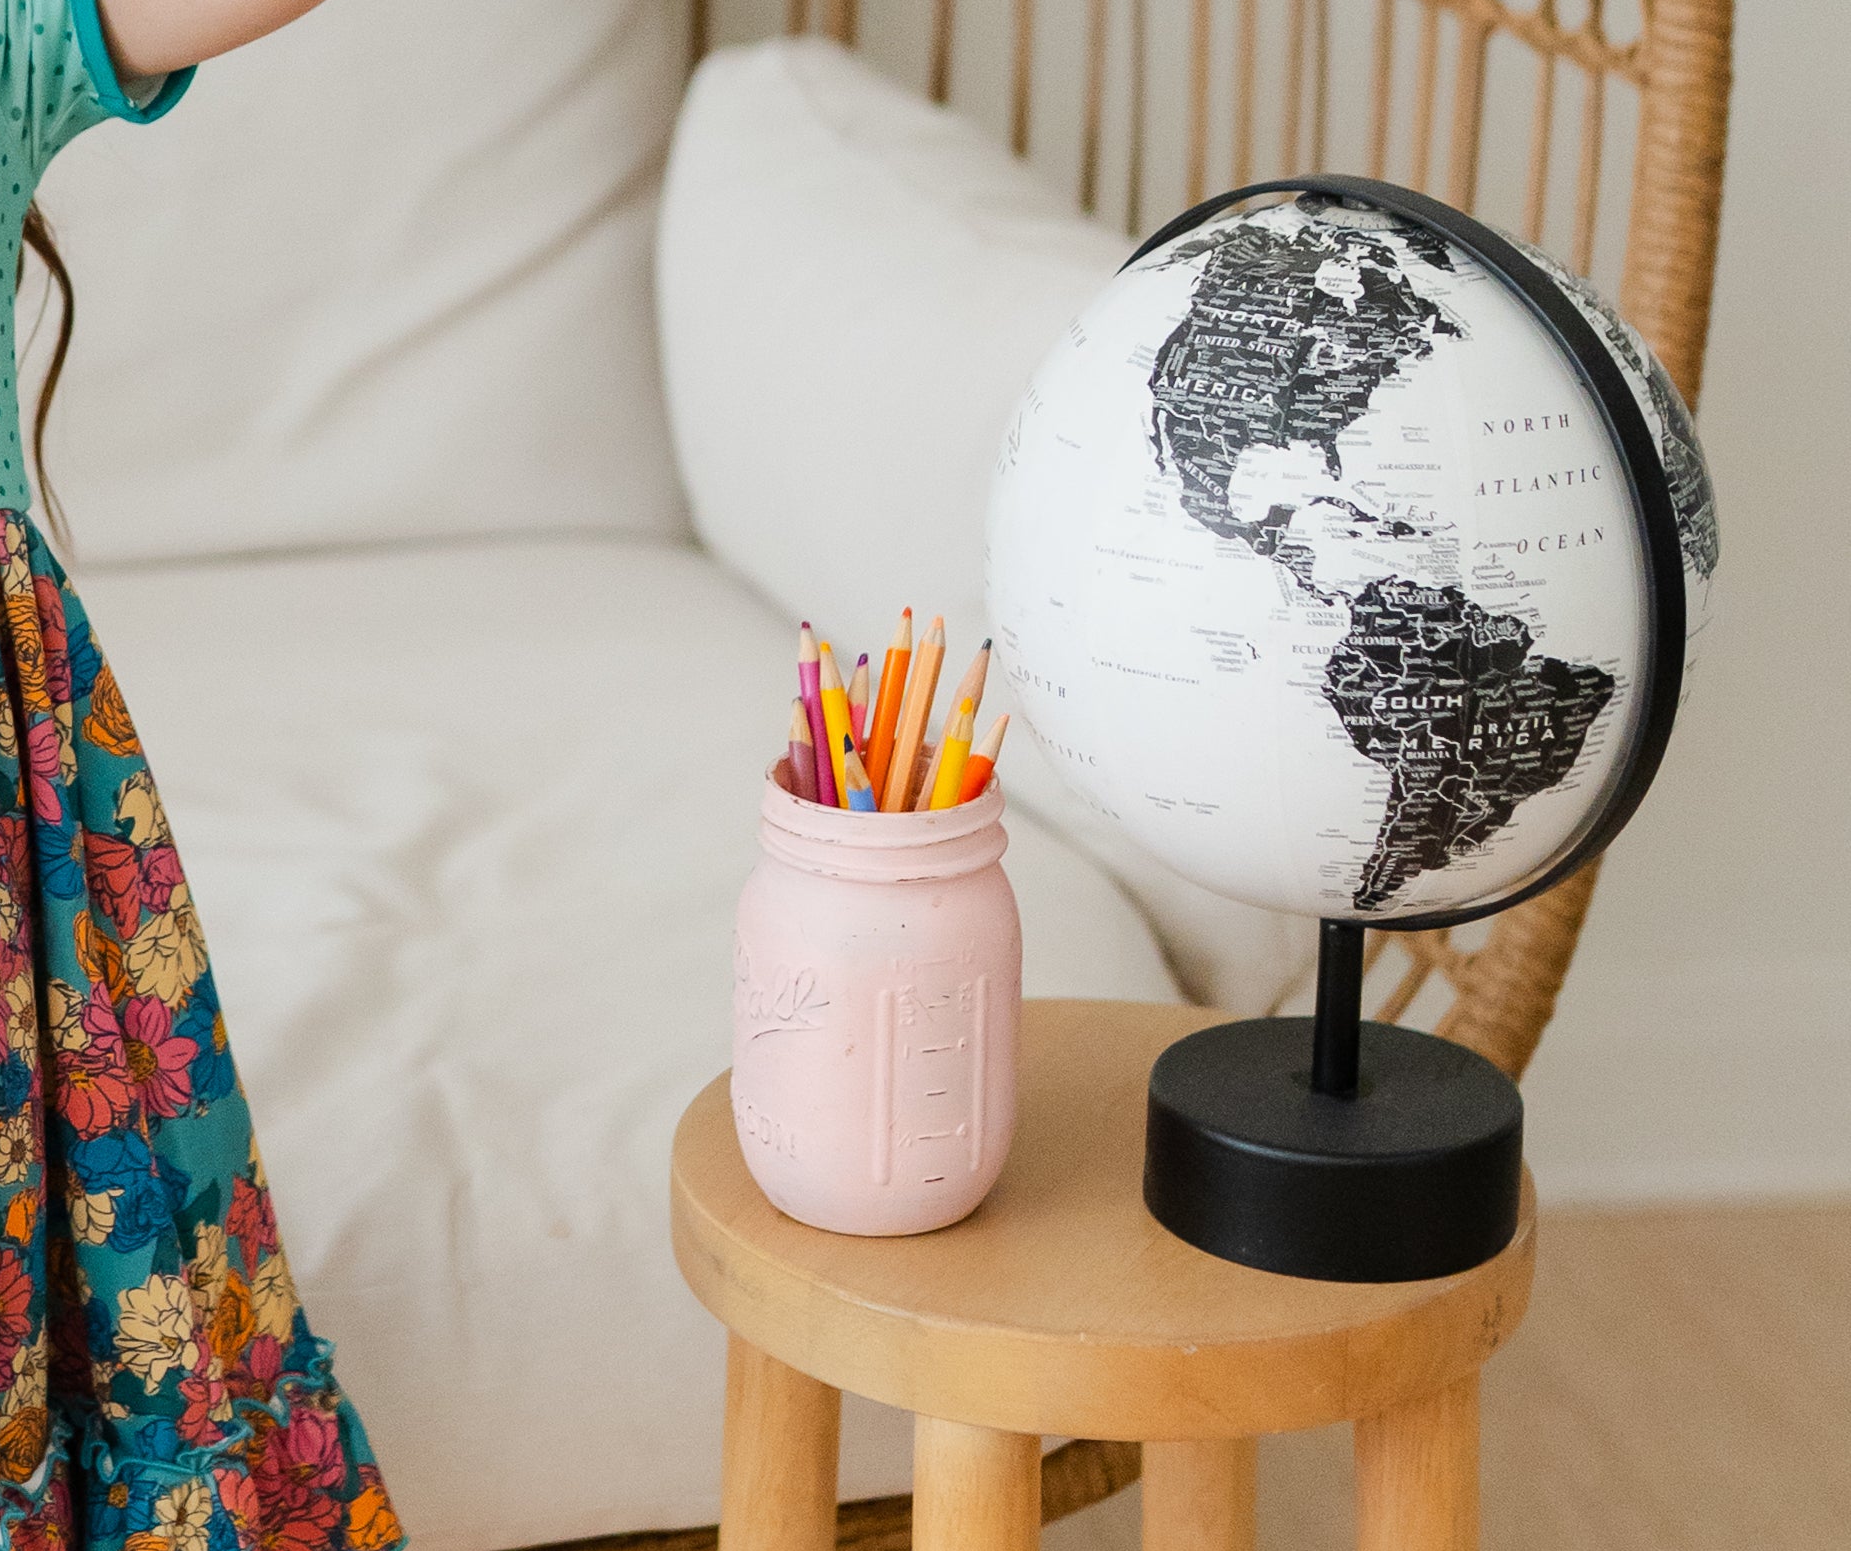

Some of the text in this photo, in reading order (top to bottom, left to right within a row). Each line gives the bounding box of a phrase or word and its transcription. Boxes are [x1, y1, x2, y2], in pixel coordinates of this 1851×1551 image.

[1222, 277, 1315, 299] CANADA
[1211, 309, 1305, 333] NORTH
[1194, 334, 1295, 359] UNITED STATES
[1154, 374, 1276, 408] AMERICA
[1482, 413, 1570, 436] NORTH
[1182, 458, 1225, 498] MEXICO
[1475, 464, 1602, 497] ATLANTIC
[1516, 526, 1605, 555] OCEAN
[1305, 611, 1345, 620] CENTRAL
[1372, 695, 1463, 709] SOUTH
[1343, 715, 1376, 726] PERU
[1473, 715, 1553, 736] BRAZIL
[1366, 728, 1556, 751] AMERICA
[1405, 750, 1452, 760] BOLIVIA
